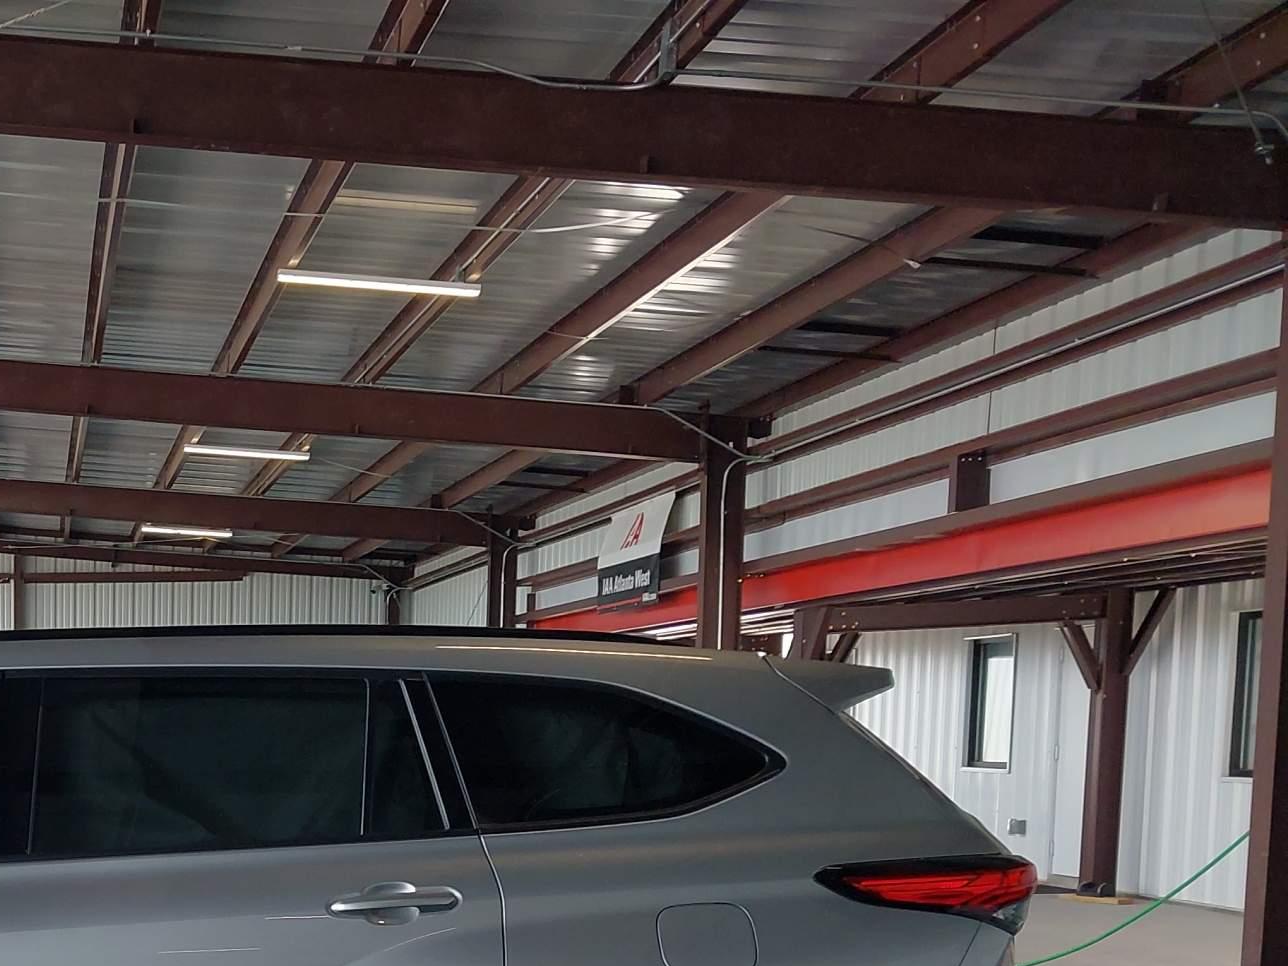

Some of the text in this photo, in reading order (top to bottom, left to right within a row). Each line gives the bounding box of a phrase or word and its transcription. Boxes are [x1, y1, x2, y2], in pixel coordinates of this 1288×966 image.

[602, 569, 650, 595] IAA Atlanta West
